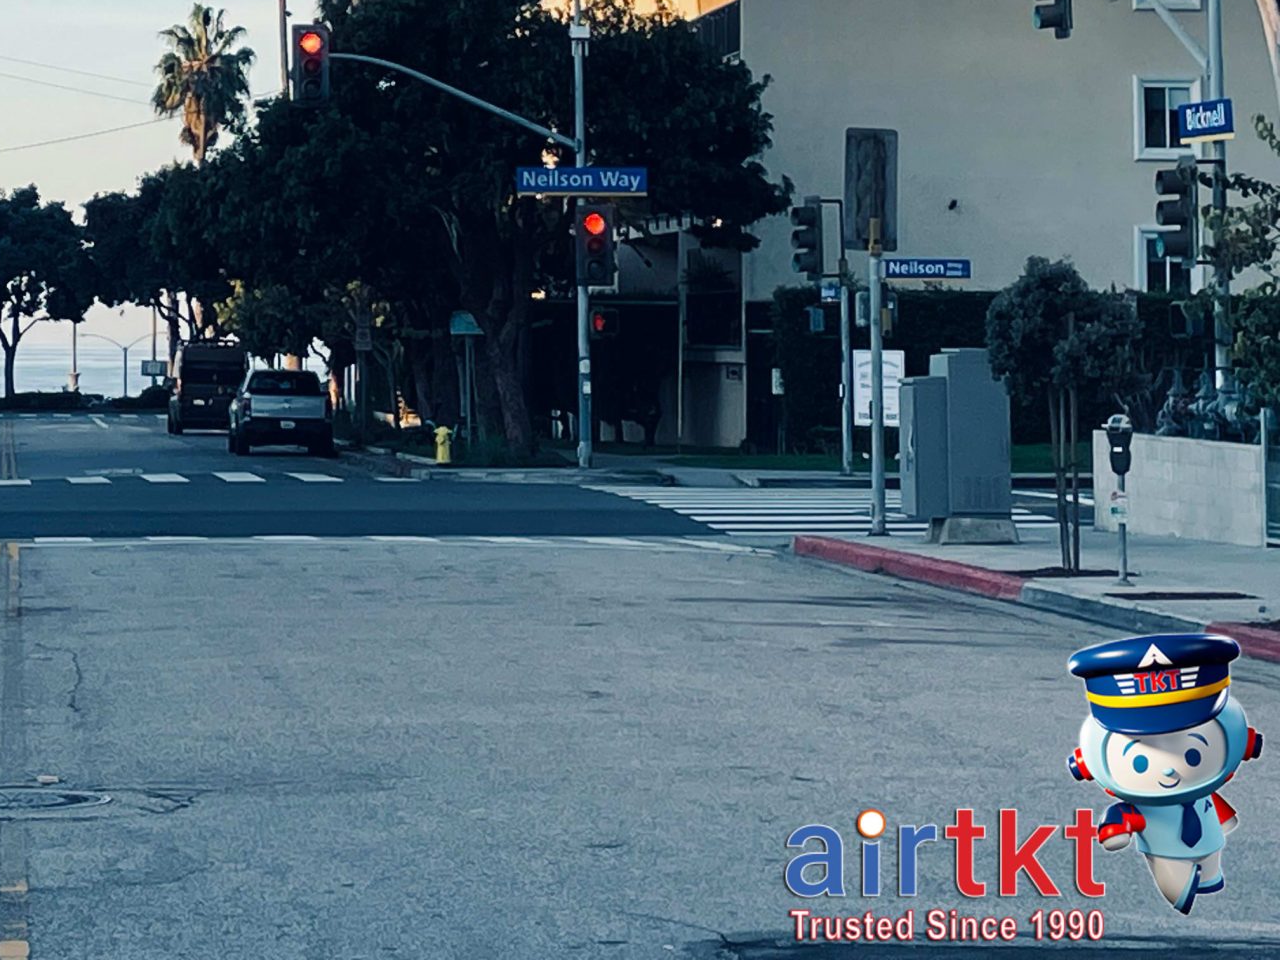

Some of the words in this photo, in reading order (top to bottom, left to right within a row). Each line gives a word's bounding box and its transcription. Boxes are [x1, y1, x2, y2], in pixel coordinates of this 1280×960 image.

[1185, 102, 1225, 131] Bicknell
[522, 170, 593, 187] Neilson
[600, 170, 640, 192] Way
[888, 261, 945, 275] Neilson
